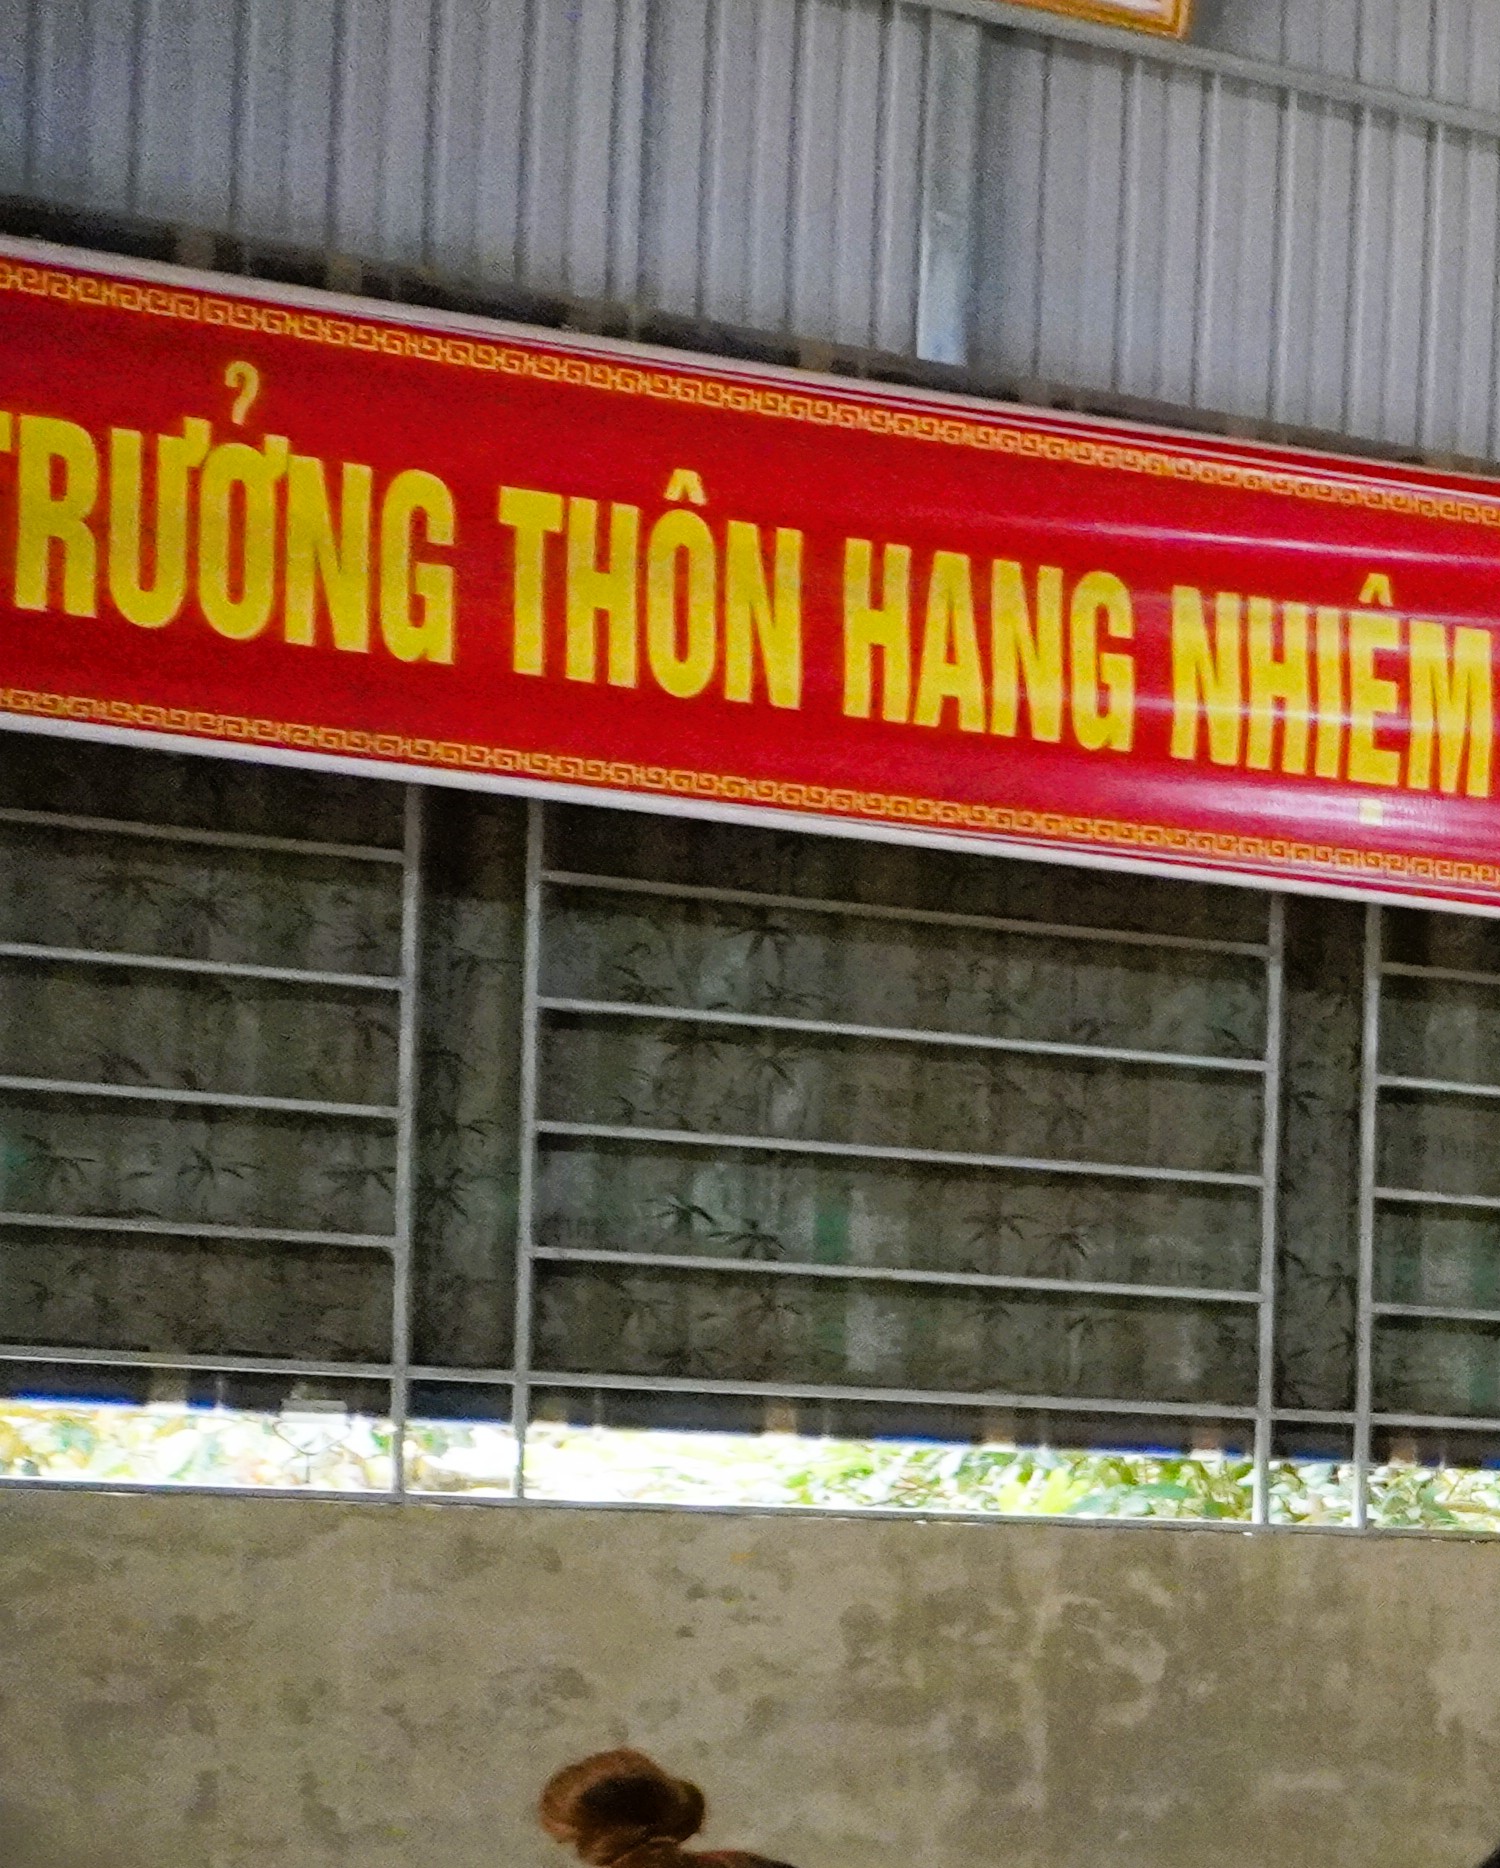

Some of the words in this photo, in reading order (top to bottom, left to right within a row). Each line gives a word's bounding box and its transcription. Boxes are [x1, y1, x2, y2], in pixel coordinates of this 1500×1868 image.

[0, 360, 455, 665] RƯỞNG
[499, 468, 802, 709] THÔN
[844, 539, 1133, 752] HANG
[1171, 572, 1492, 825] NHIỆM
